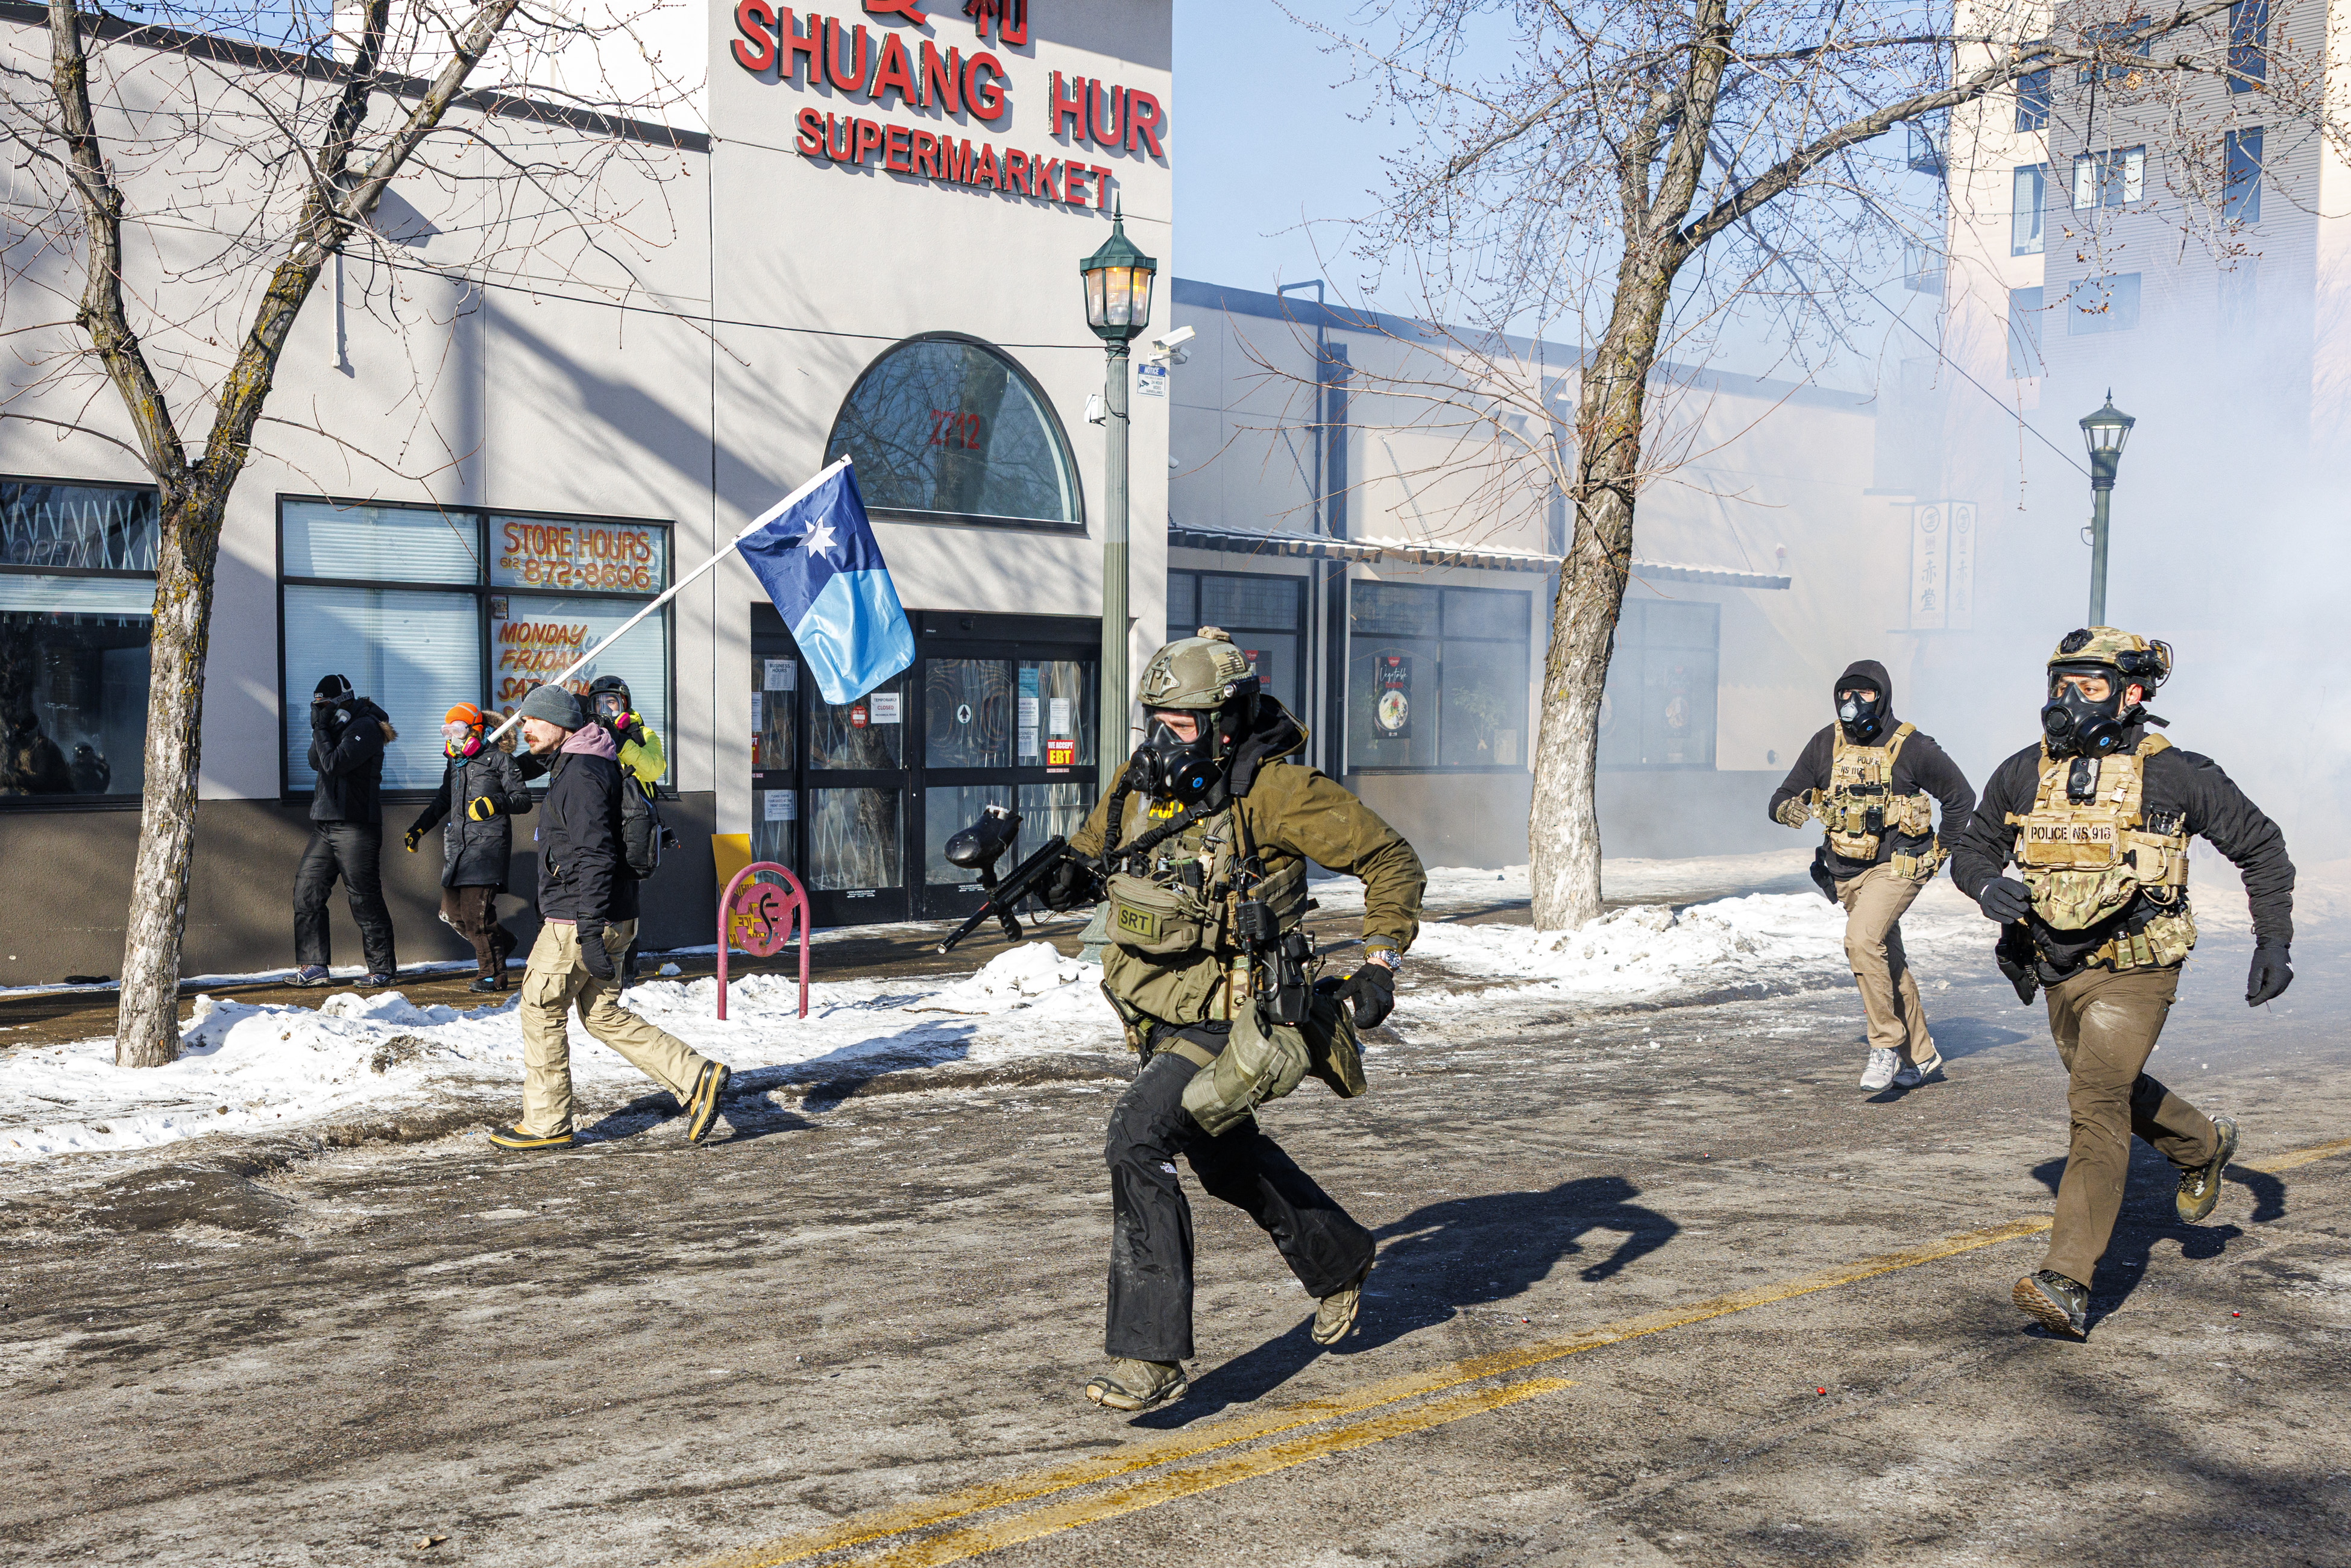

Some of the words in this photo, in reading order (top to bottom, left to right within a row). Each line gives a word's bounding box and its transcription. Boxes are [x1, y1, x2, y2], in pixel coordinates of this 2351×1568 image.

[730, 0, 1004, 120] SHUANG
[1048, 71, 1162, 157] HUR
[793, 107, 1112, 209] SUPERMARKET
[1145, 366, 1159, 375] NOTICE
[930, 409, 980, 449] 2712
[10, 538, 89, 567] OPEN
[504, 522, 573, 556] STORE
[578, 527, 652, 563] HOURS
[500, 556, 520, 569] 612
[498, 622, 588, 648] MONDAY
[499, 649, 583, 672] FRIDAY
[1379, 664, 1408, 684] Vegetable
[1050, 750, 1071, 764] EBT
[1857, 755, 1880, 765] POLICE
[1840, 766, 1849, 775] NS
[2031, 827, 2067, 840] POLICE
[2072, 827, 2089, 840] NS
[1120, 909, 1149, 931] SRT
